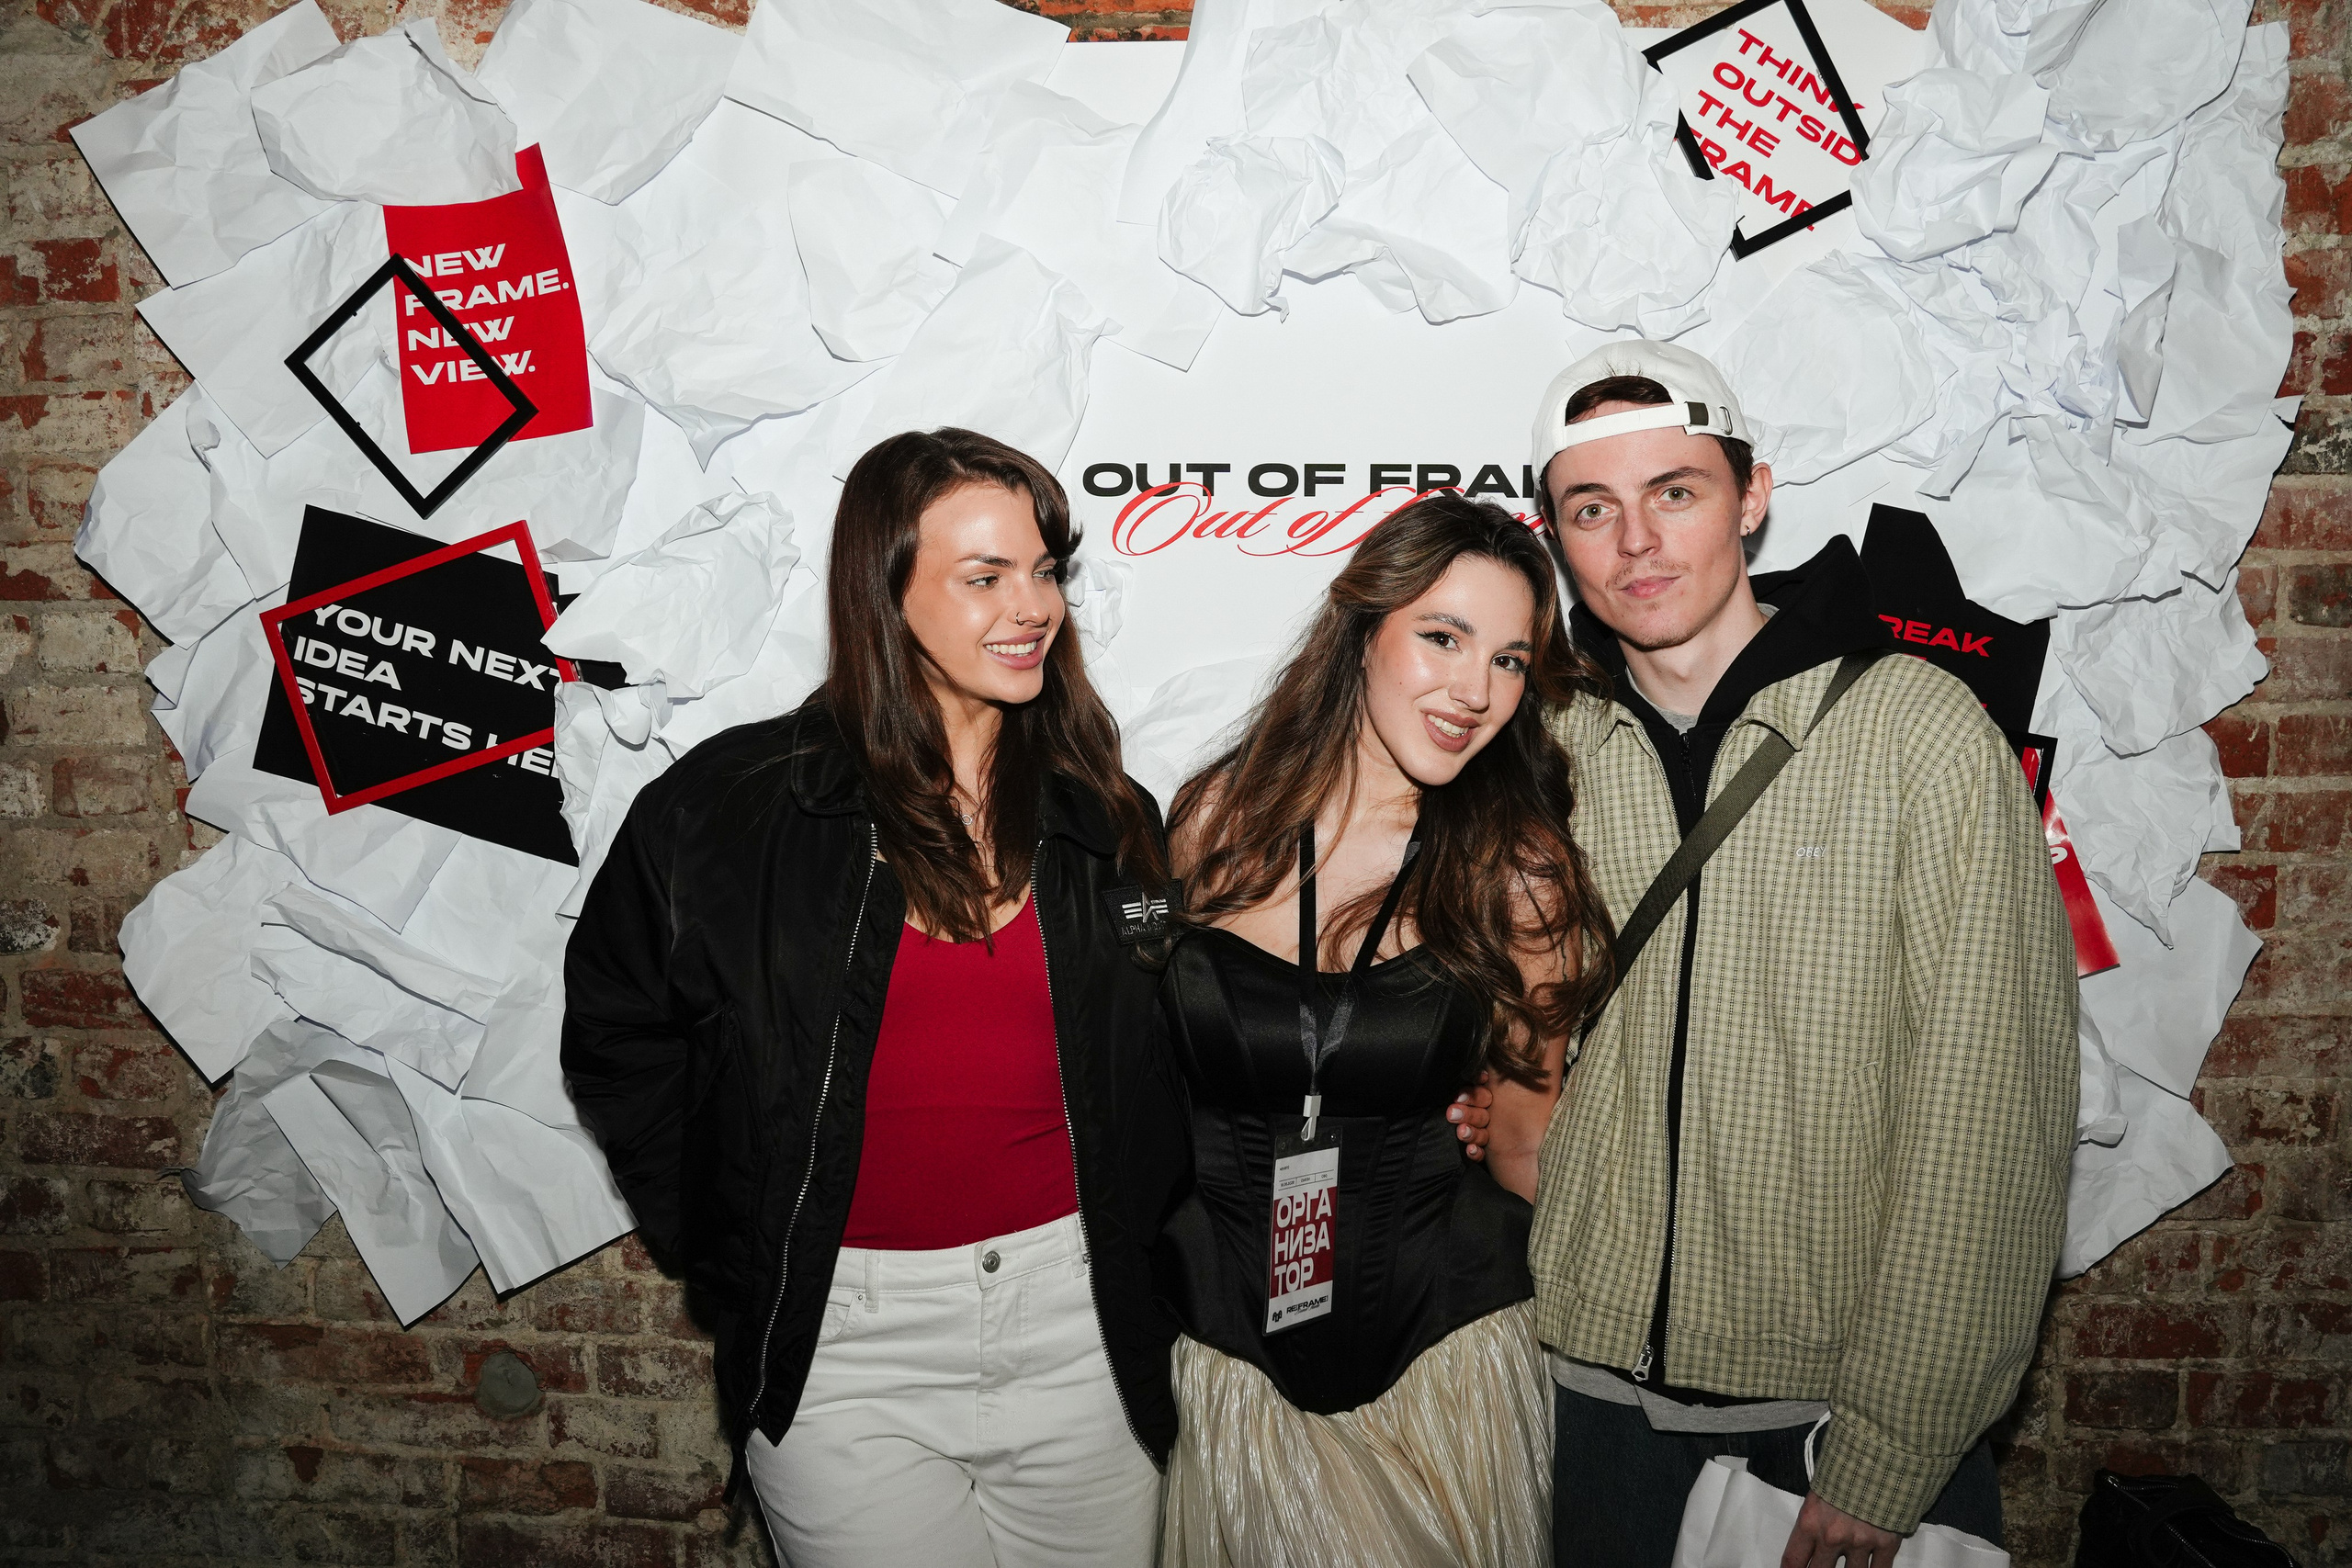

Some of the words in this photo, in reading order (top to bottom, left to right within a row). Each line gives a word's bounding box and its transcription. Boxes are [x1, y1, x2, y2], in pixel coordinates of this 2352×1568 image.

[1697, 89, 1781, 159] THE
[1713, 62, 1863, 166] OUTSID
[403, 243, 506, 278] NEW
[404, 268, 570, 317] FRAME.
[410, 350, 537, 386] VIEW.
[1082, 462, 1231, 497] OUT
[1248, 463, 1346, 497] OF
[1112, 481, 1295, 557] Out
[314, 604, 436, 659] YOUR
[1878, 614, 1994, 658] REAK
[293, 635, 402, 692] IDEA
[295, 676, 473, 751] STARTS
[1795, 846, 1826, 858] OBEY
[1276, 1188, 1332, 1229] ОРГА
[1274, 1222, 1330, 1265] НИЗА
[1274, 1257, 1314, 1297] ТОР
